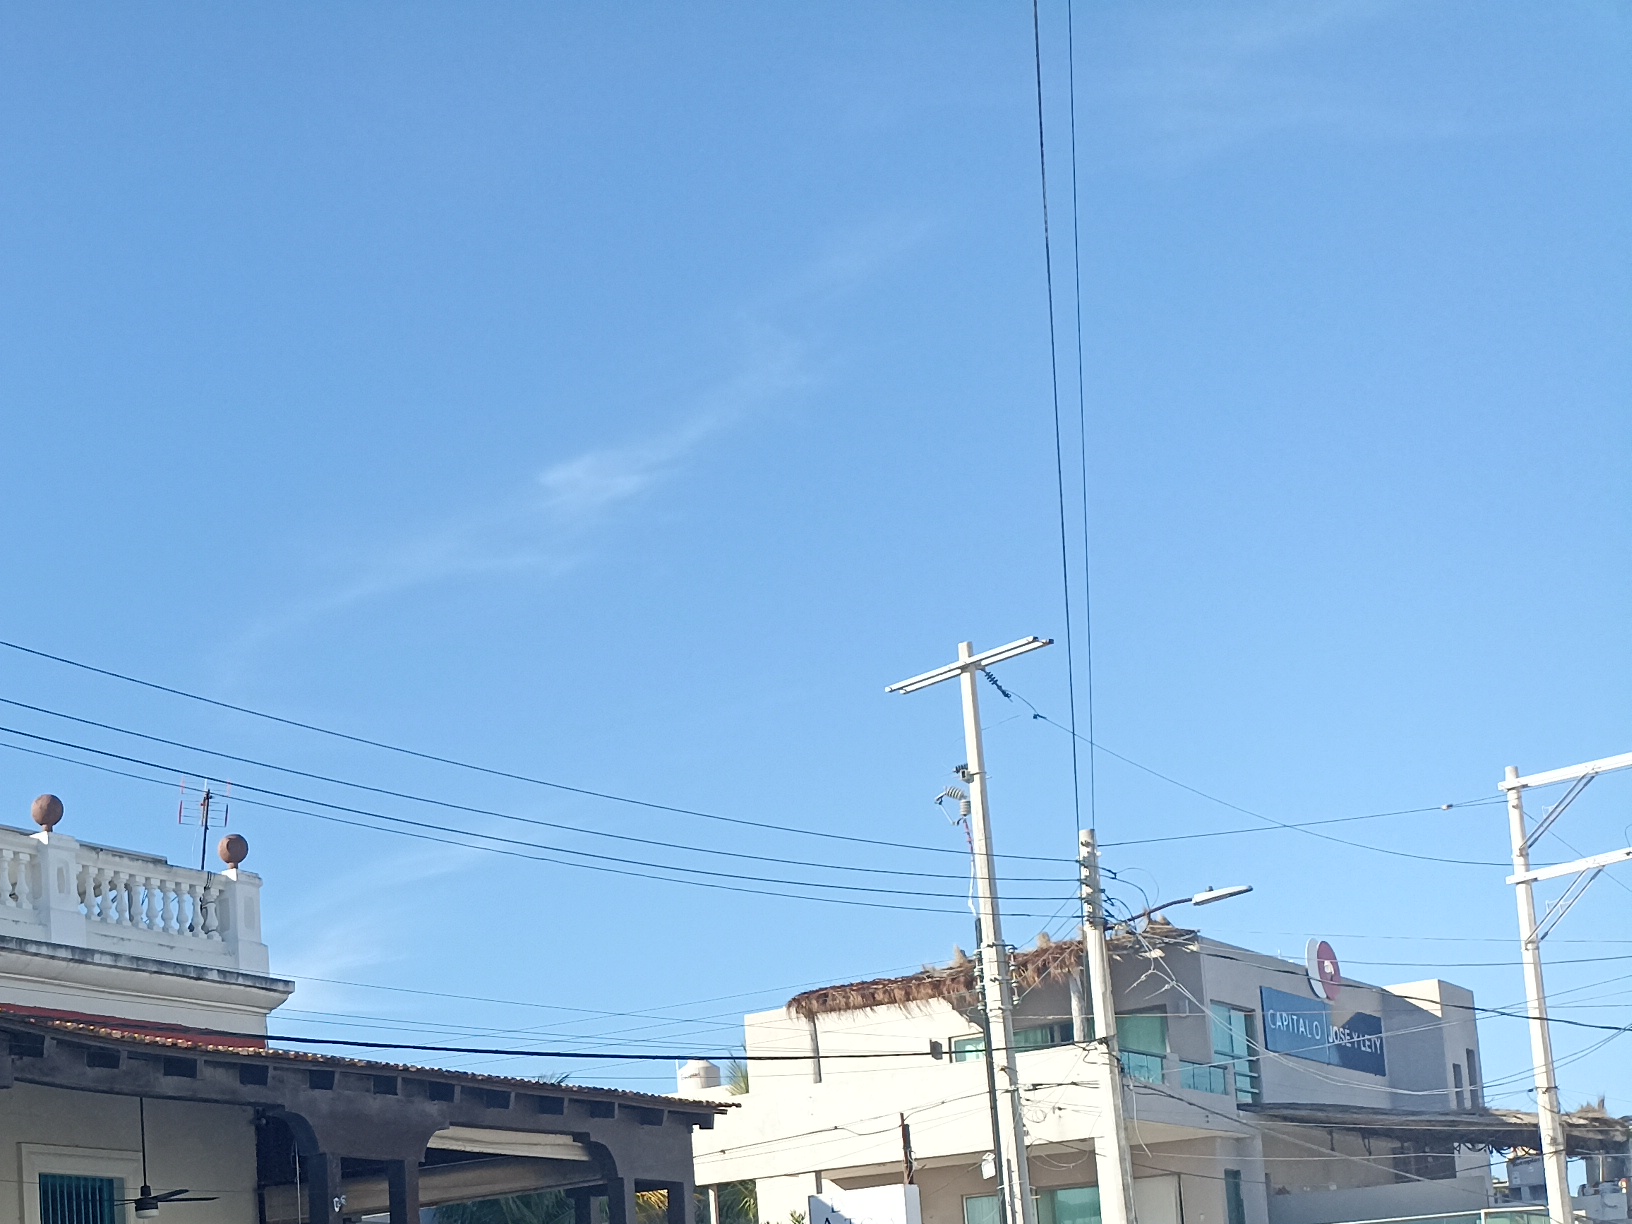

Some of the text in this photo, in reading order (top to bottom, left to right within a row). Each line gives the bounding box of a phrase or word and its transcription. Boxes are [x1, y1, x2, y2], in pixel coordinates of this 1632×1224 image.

[1268, 1009, 1321, 1040] CAPITAL O
[1352, 1032, 1359, 1049] Y
[1360, 1034, 1381, 1055] LETY
